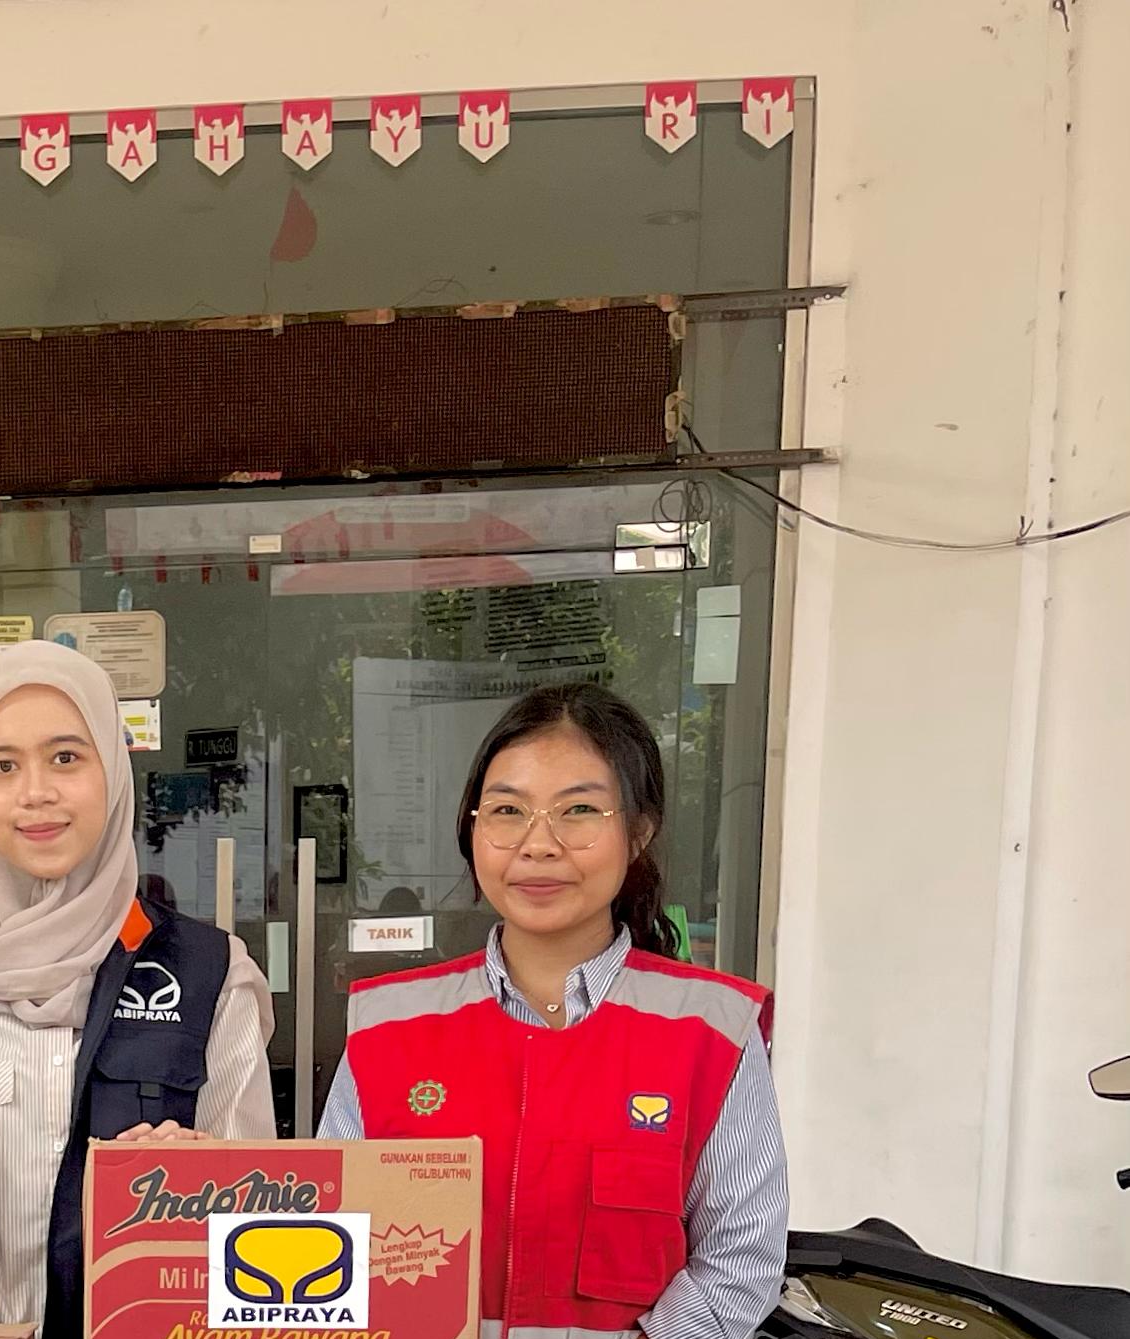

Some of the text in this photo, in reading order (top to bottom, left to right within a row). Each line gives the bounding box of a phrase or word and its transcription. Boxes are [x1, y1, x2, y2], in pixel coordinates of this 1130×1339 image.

[200, 737, 237, 756] TUNGGU
[367, 927, 413, 941] TARIK
[114, 1009, 181, 1022] ABIPRAYA
[381, 1152, 467, 1164] GUNAKAN SEBELUM
[381, 1240, 422, 1255] Lengkap
[406, 1248, 440, 1261] Minyak
[160, 1268, 186, 1289] Mi
[222, 1307, 355, 1322] ABIPRAYA
[882, 1299, 968, 1330] UNITED
